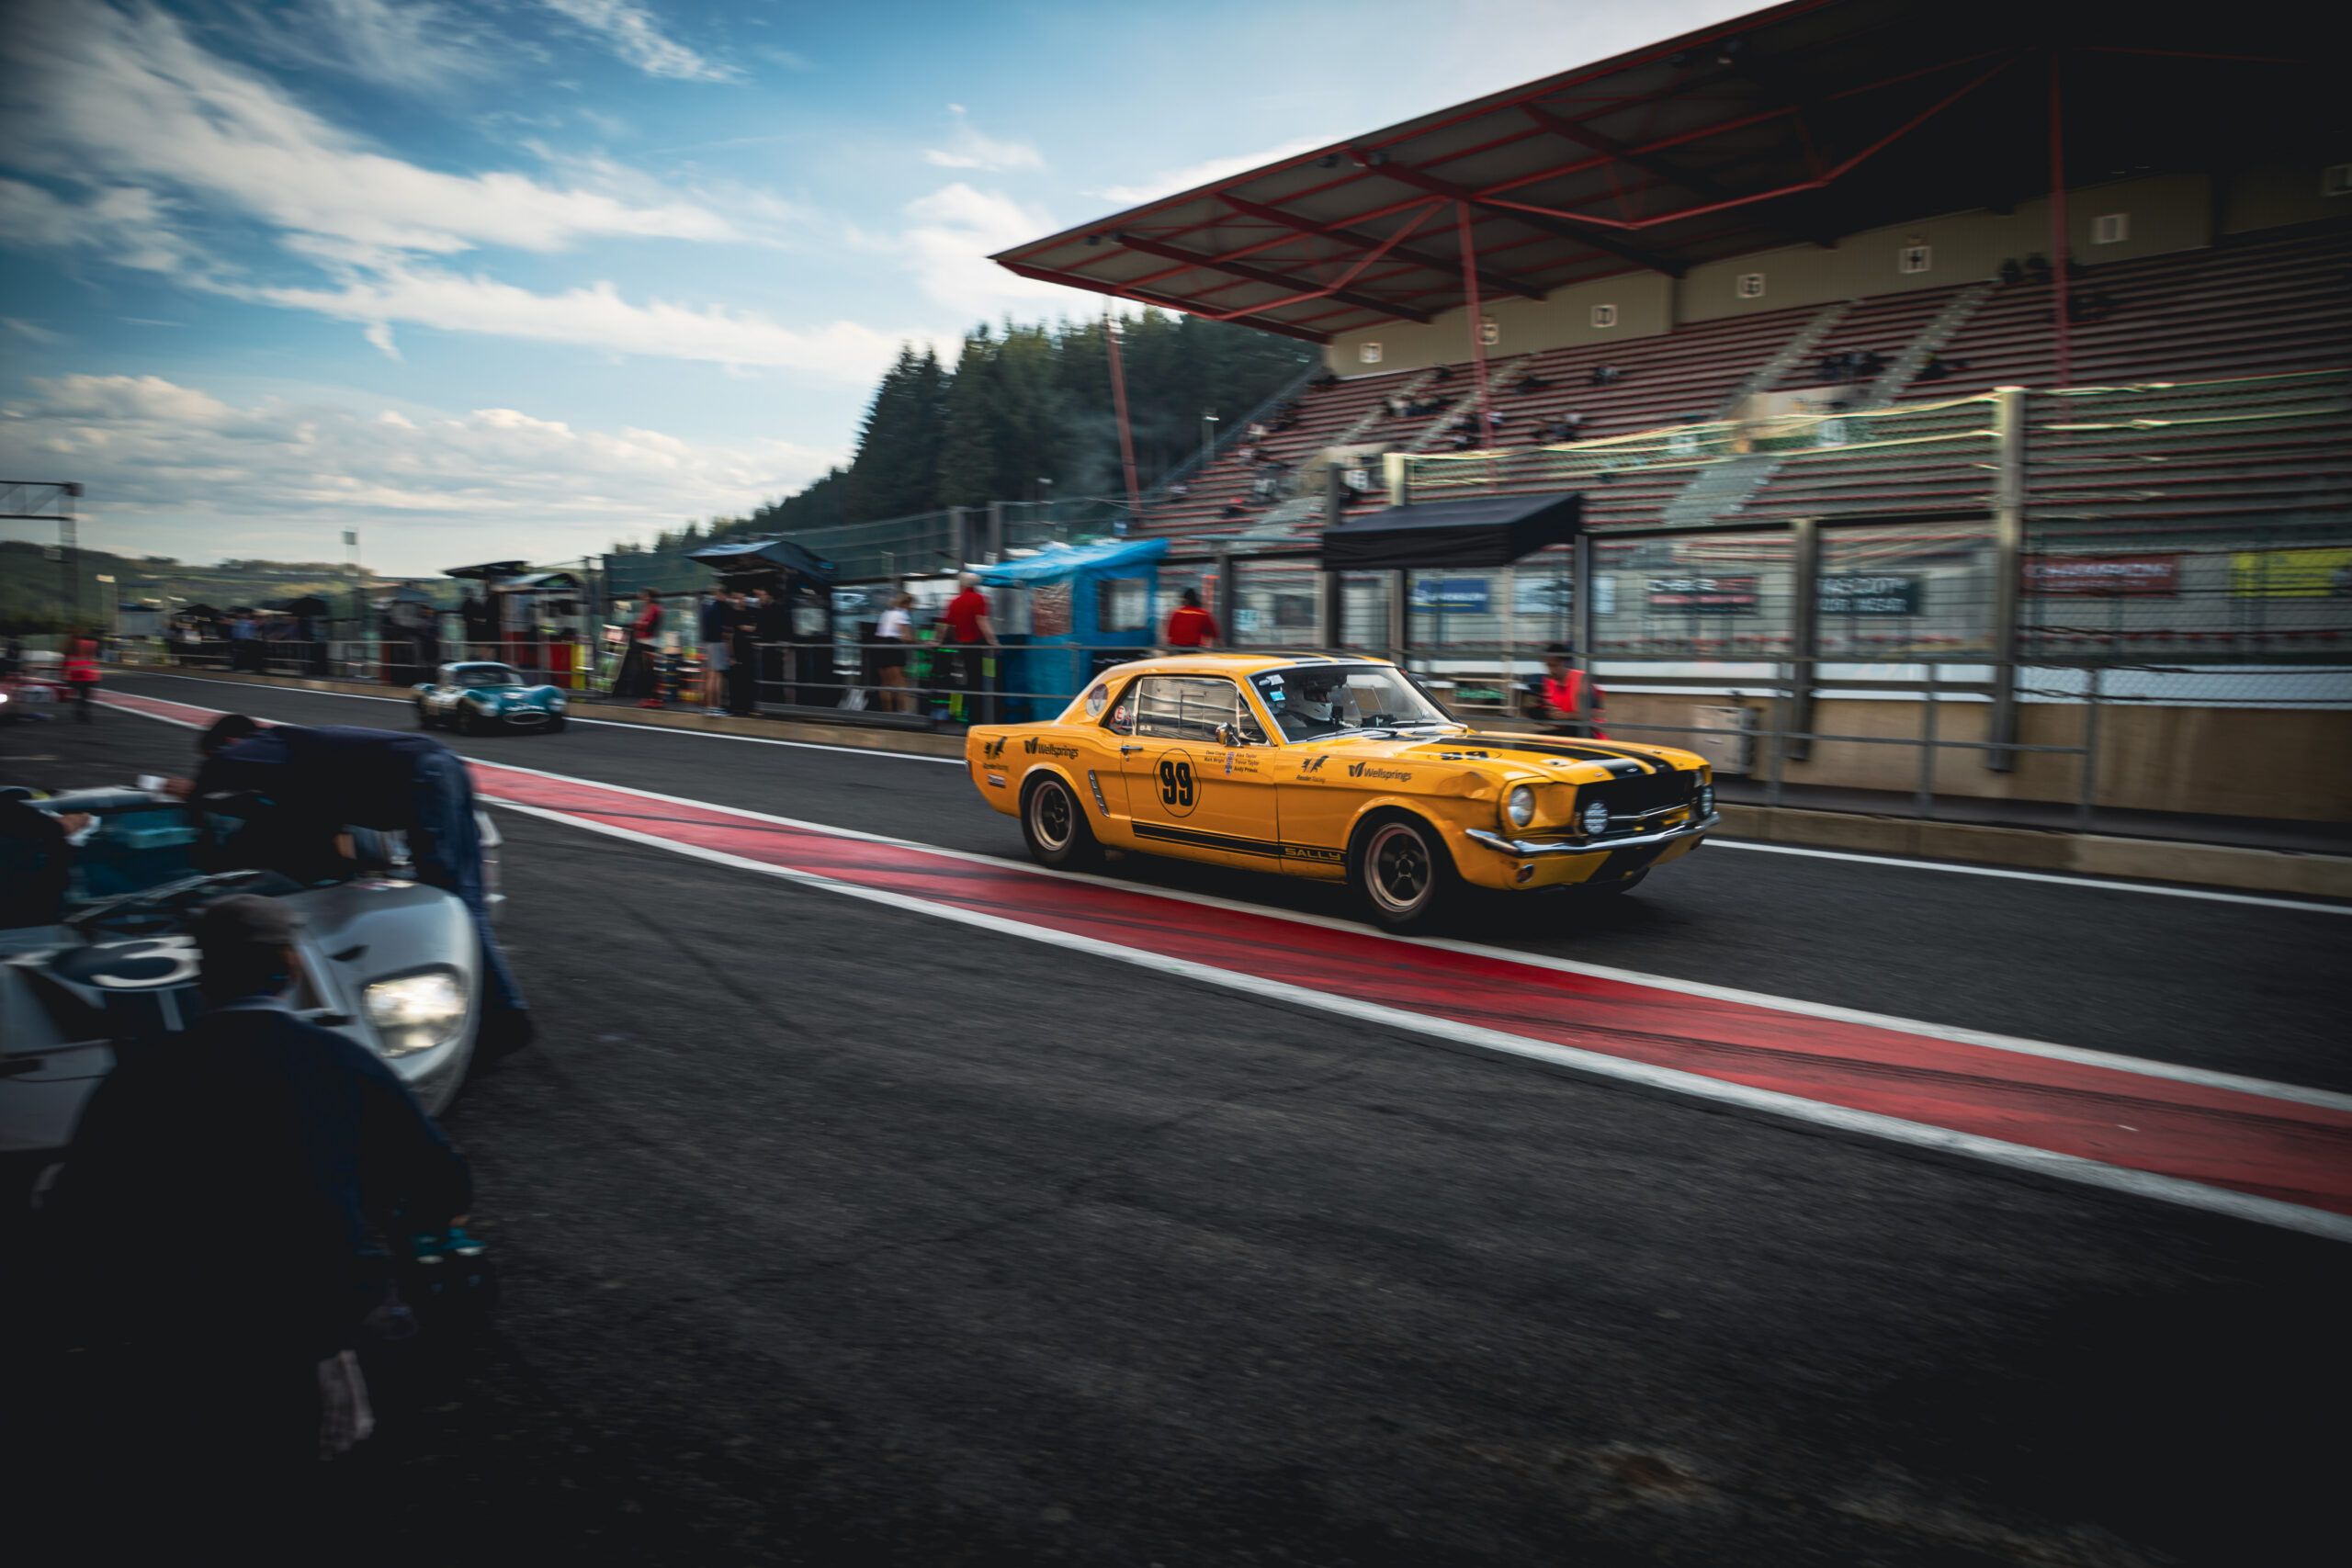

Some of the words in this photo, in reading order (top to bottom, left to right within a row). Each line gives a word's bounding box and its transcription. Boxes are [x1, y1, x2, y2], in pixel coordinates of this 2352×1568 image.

[1038, 743, 1079, 760] Wellsprings
[1364, 768, 1412, 782] Wellsprings
[1160, 761, 1193, 807] 99
[1285, 847, 1341, 861] SALLY
